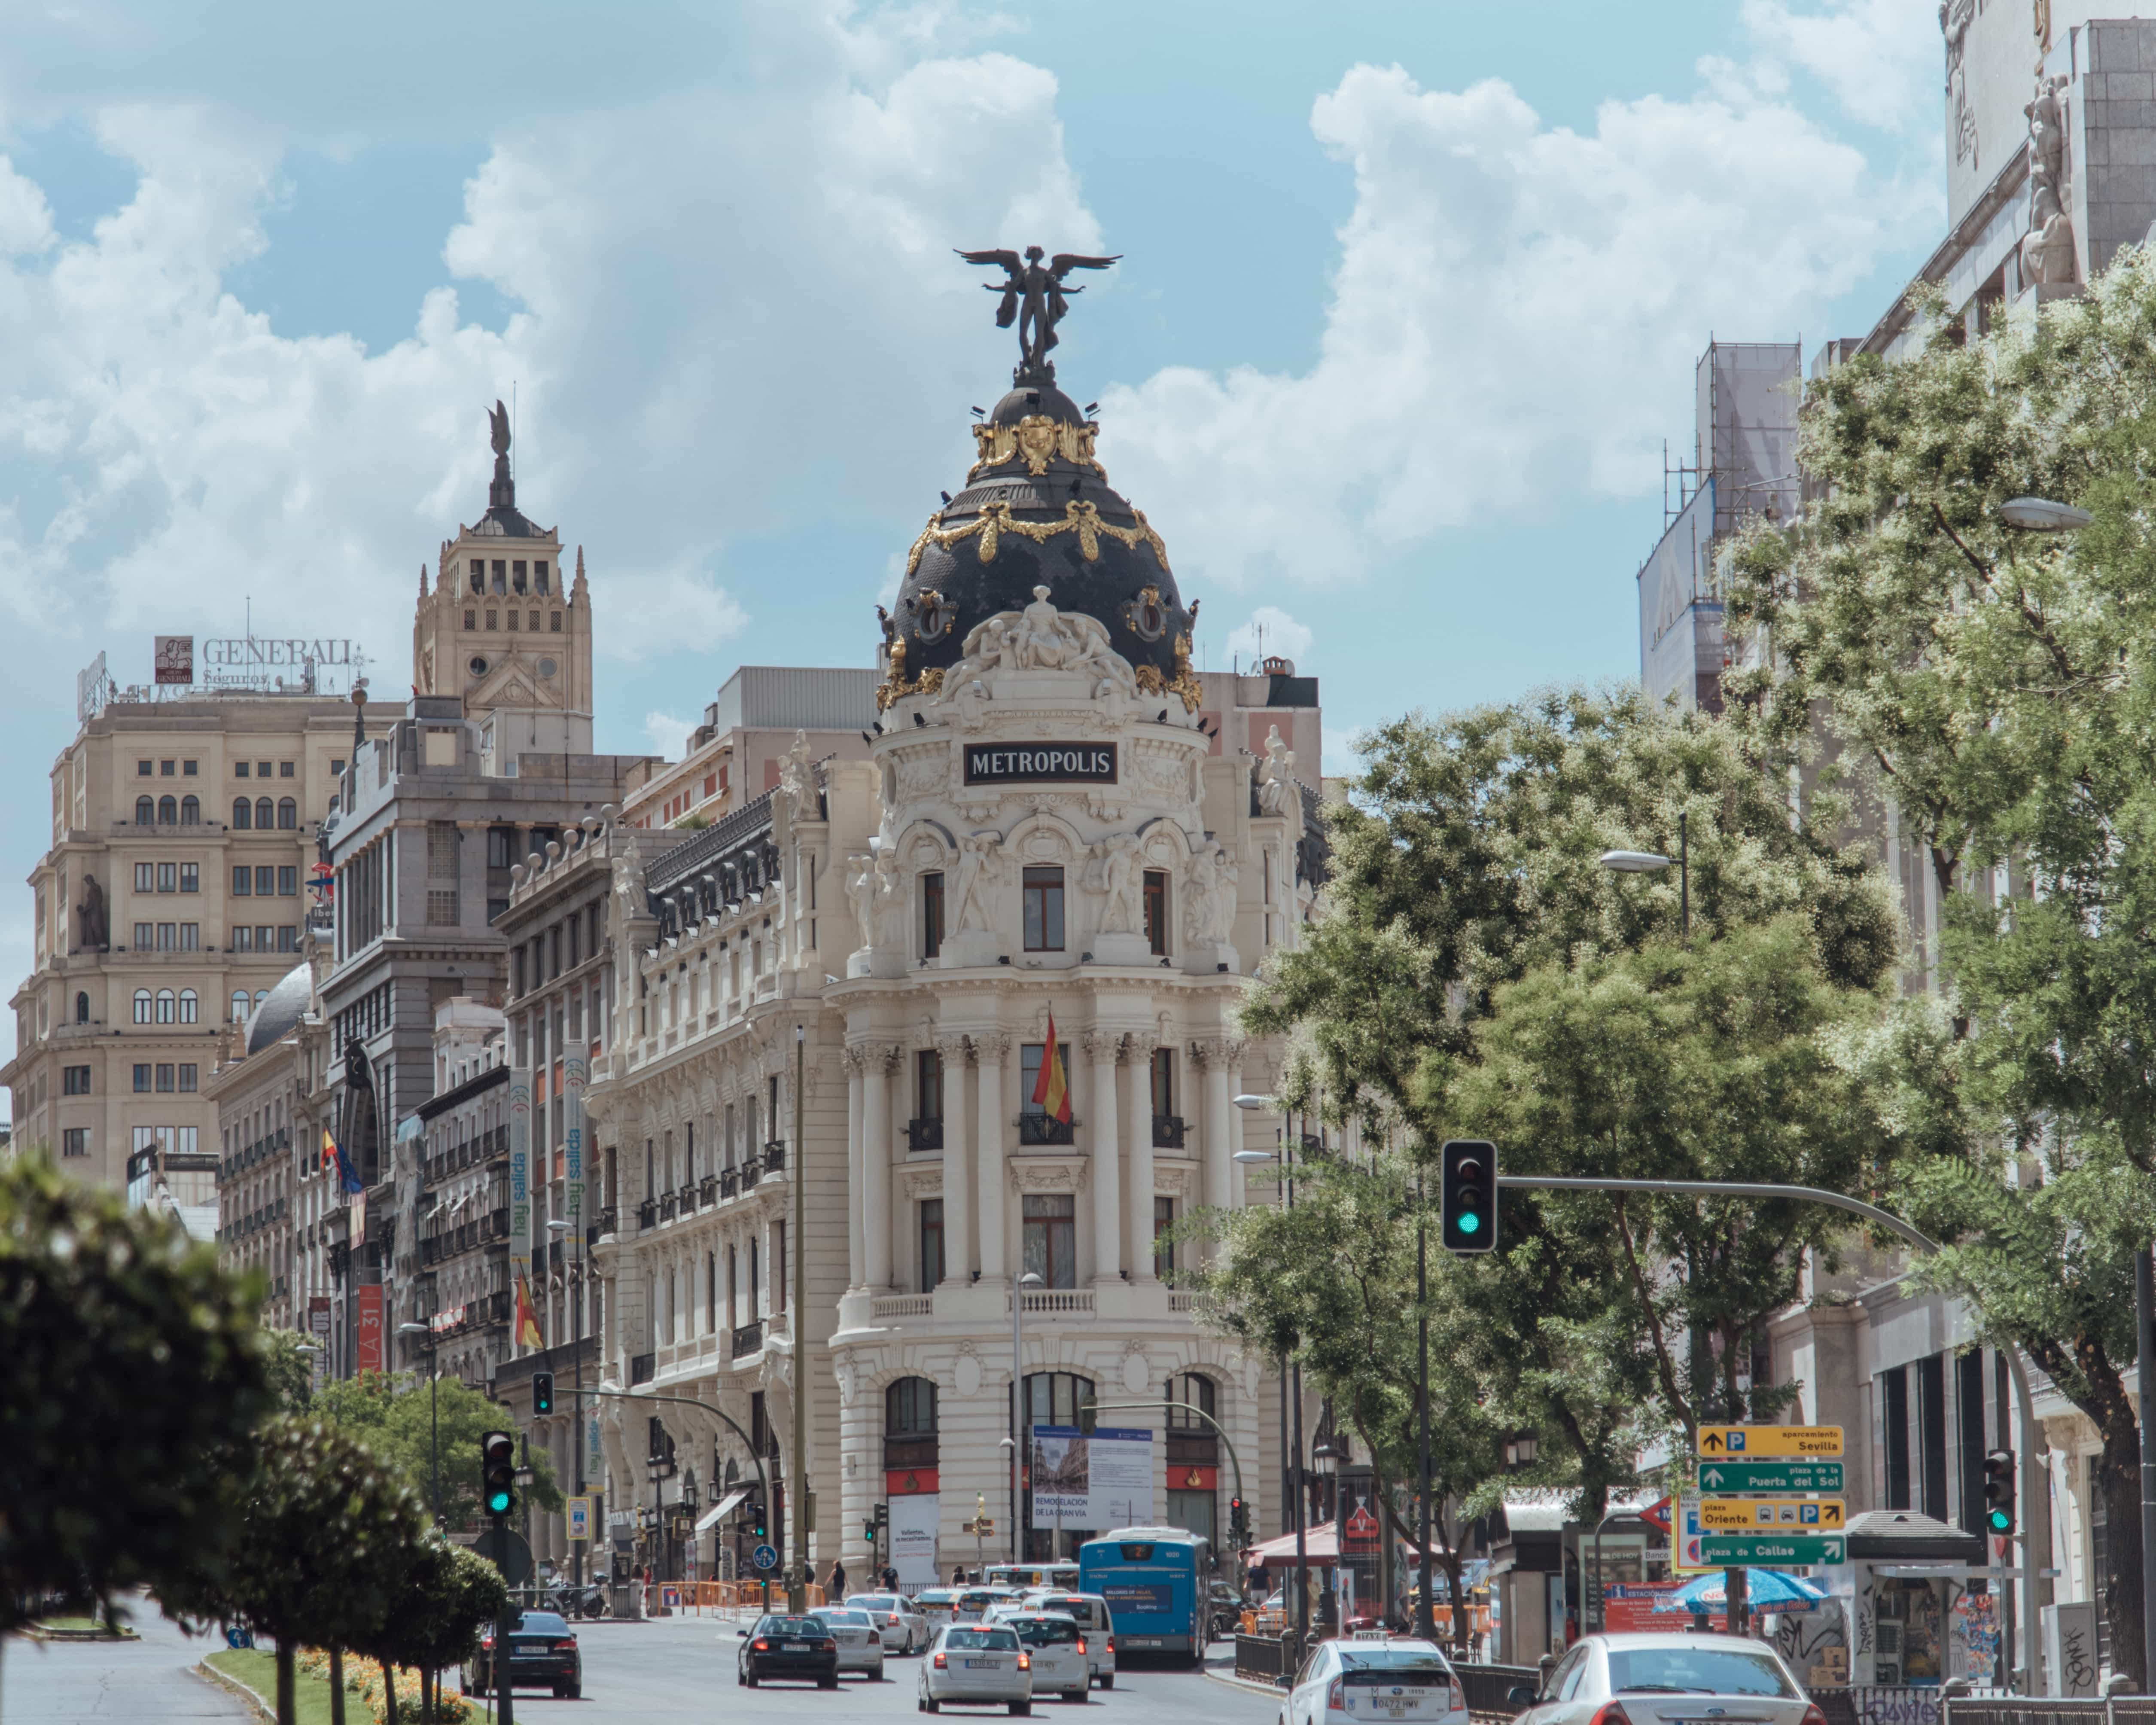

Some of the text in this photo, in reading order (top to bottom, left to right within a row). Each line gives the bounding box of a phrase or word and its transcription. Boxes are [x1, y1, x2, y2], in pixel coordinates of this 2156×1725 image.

[203, 639, 351, 665] GENERALI
[203, 670, 268, 688] Seguros
[973, 752, 1110, 774] METROPOLIS
[566, 1128, 581, 1179] salida
[511, 1153, 526, 1201] salida
[566, 1183, 585, 1216] hay
[511, 1205, 530, 1236] hay
[362, 1309, 379, 1328] 31
[1730, 1434, 1743, 1450] P
[1799, 1442, 1838, 1451] Sevilla
[1789, 1467, 1812, 1475] plaza
[1749, 1477, 1839, 1487] Puerta del Sol
[1035, 1497, 1088, 1506] REMODELACIÓN
[1056, 1509, 1074, 1517] GRAN
[1075, 1508, 1087, 1518] VÍA
[1705, 1515, 1748, 1524] Oriente
[1803, 1506, 1816, 1523] P
[1706, 1545, 1795, 1557] plaza de Callao
[1379, 1700, 1419, 1708] 0472 HMV
